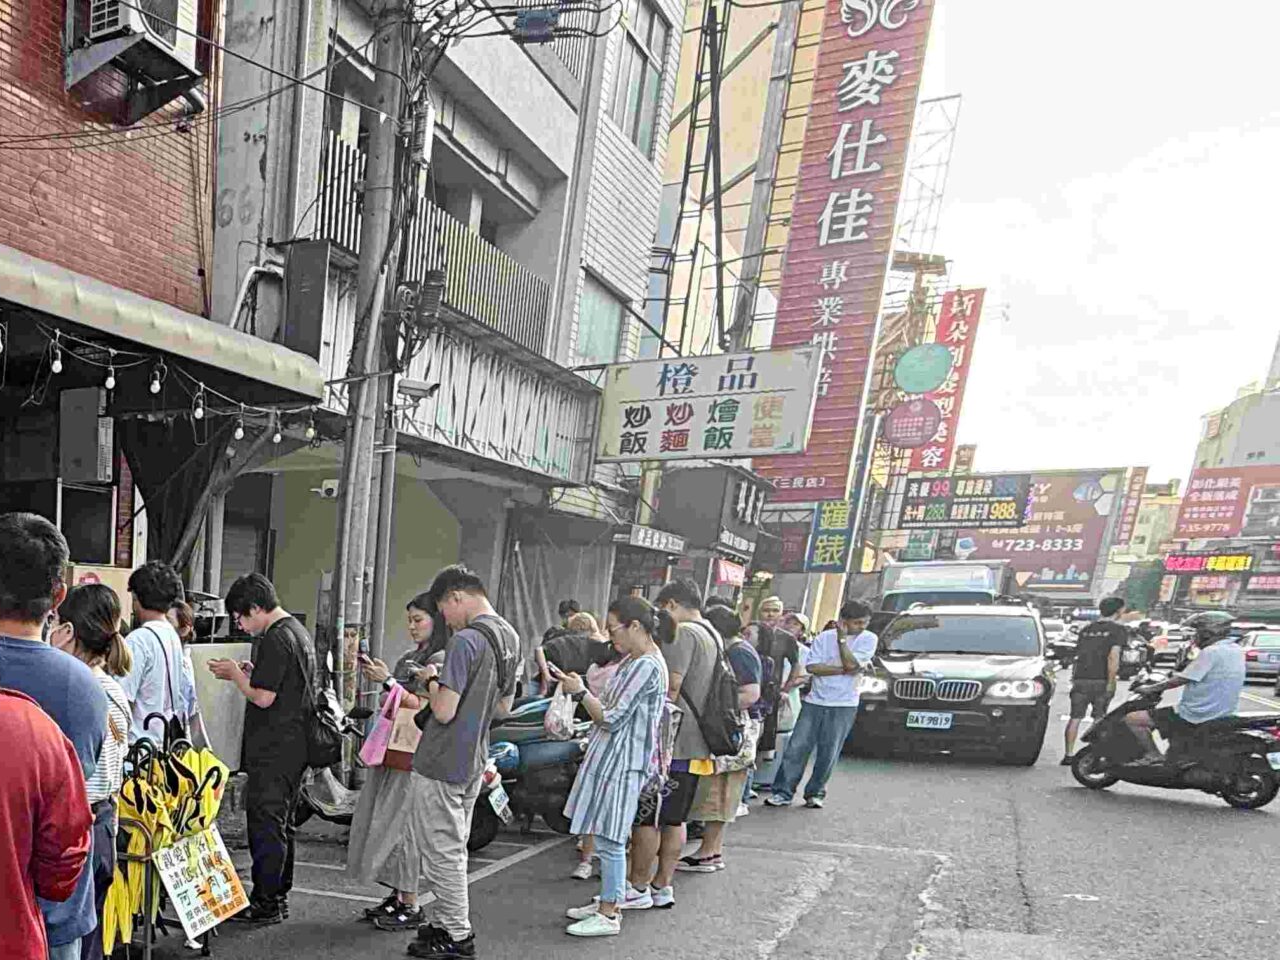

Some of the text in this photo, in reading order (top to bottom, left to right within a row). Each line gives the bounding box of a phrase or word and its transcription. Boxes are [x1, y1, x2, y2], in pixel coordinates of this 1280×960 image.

[816, 49, 900, 246] 麥仕佳
[656, 355, 758, 397] 橙品
[620, 403, 652, 455] 炒飯
[659, 401, 694, 454] 炒麵
[703, 398, 741, 452] 燴飯
[1005, 538, 1084, 552] 723-8333
